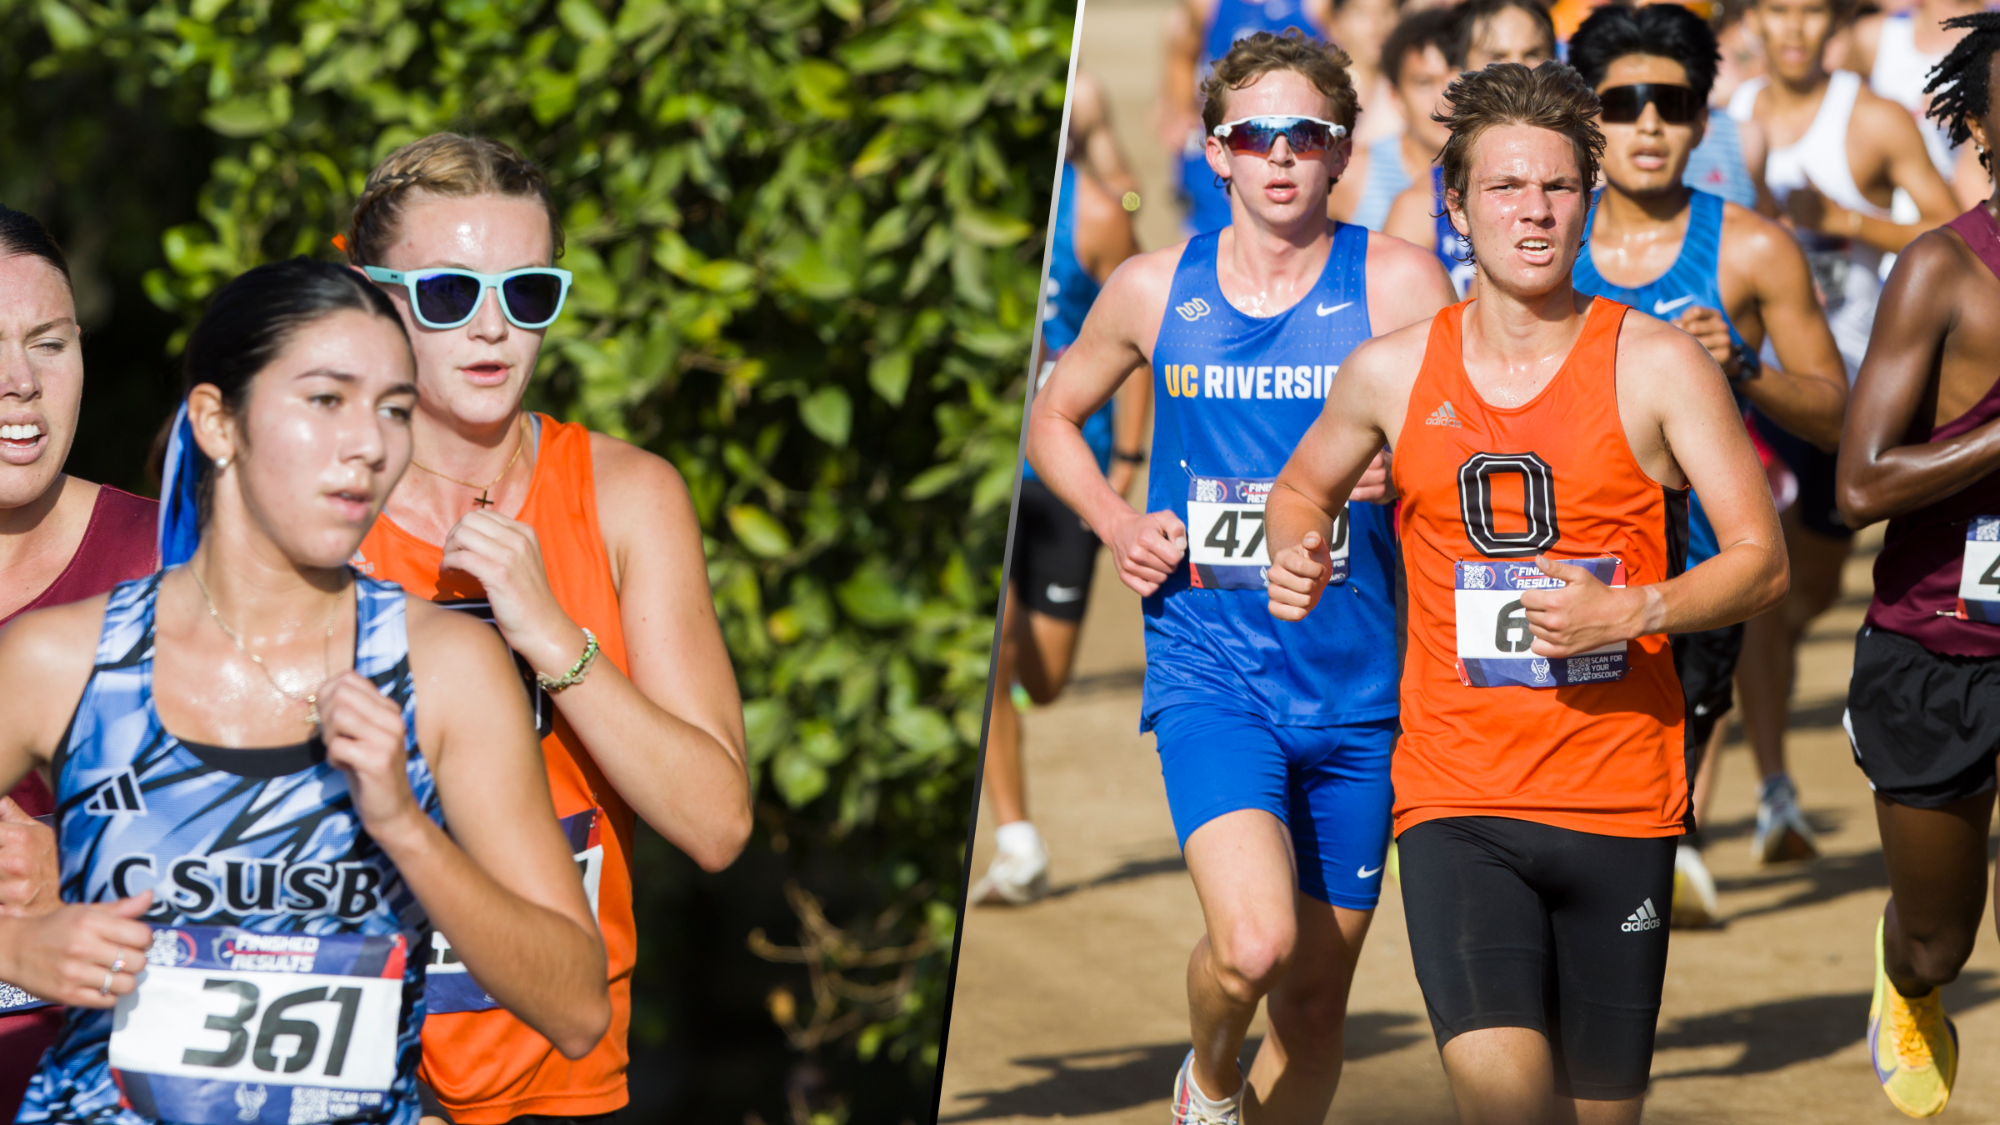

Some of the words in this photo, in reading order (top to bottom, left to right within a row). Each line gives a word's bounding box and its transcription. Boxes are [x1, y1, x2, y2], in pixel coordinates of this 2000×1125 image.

[1164, 364, 1198, 398] UC
[1425, 416, 1462, 428] adidas
[1516, 578, 1566, 589] RESULTS
[1591, 656, 1609, 664] SCAN
[1592, 664, 1609, 672] YOUR
[110, 854, 383, 923] CSUSB
[1621, 918, 1660, 932] adidas
[233, 933, 320, 952] FINISHED
[230, 953, 316, 973] RESULTS
[181, 978, 363, 1077] 361
